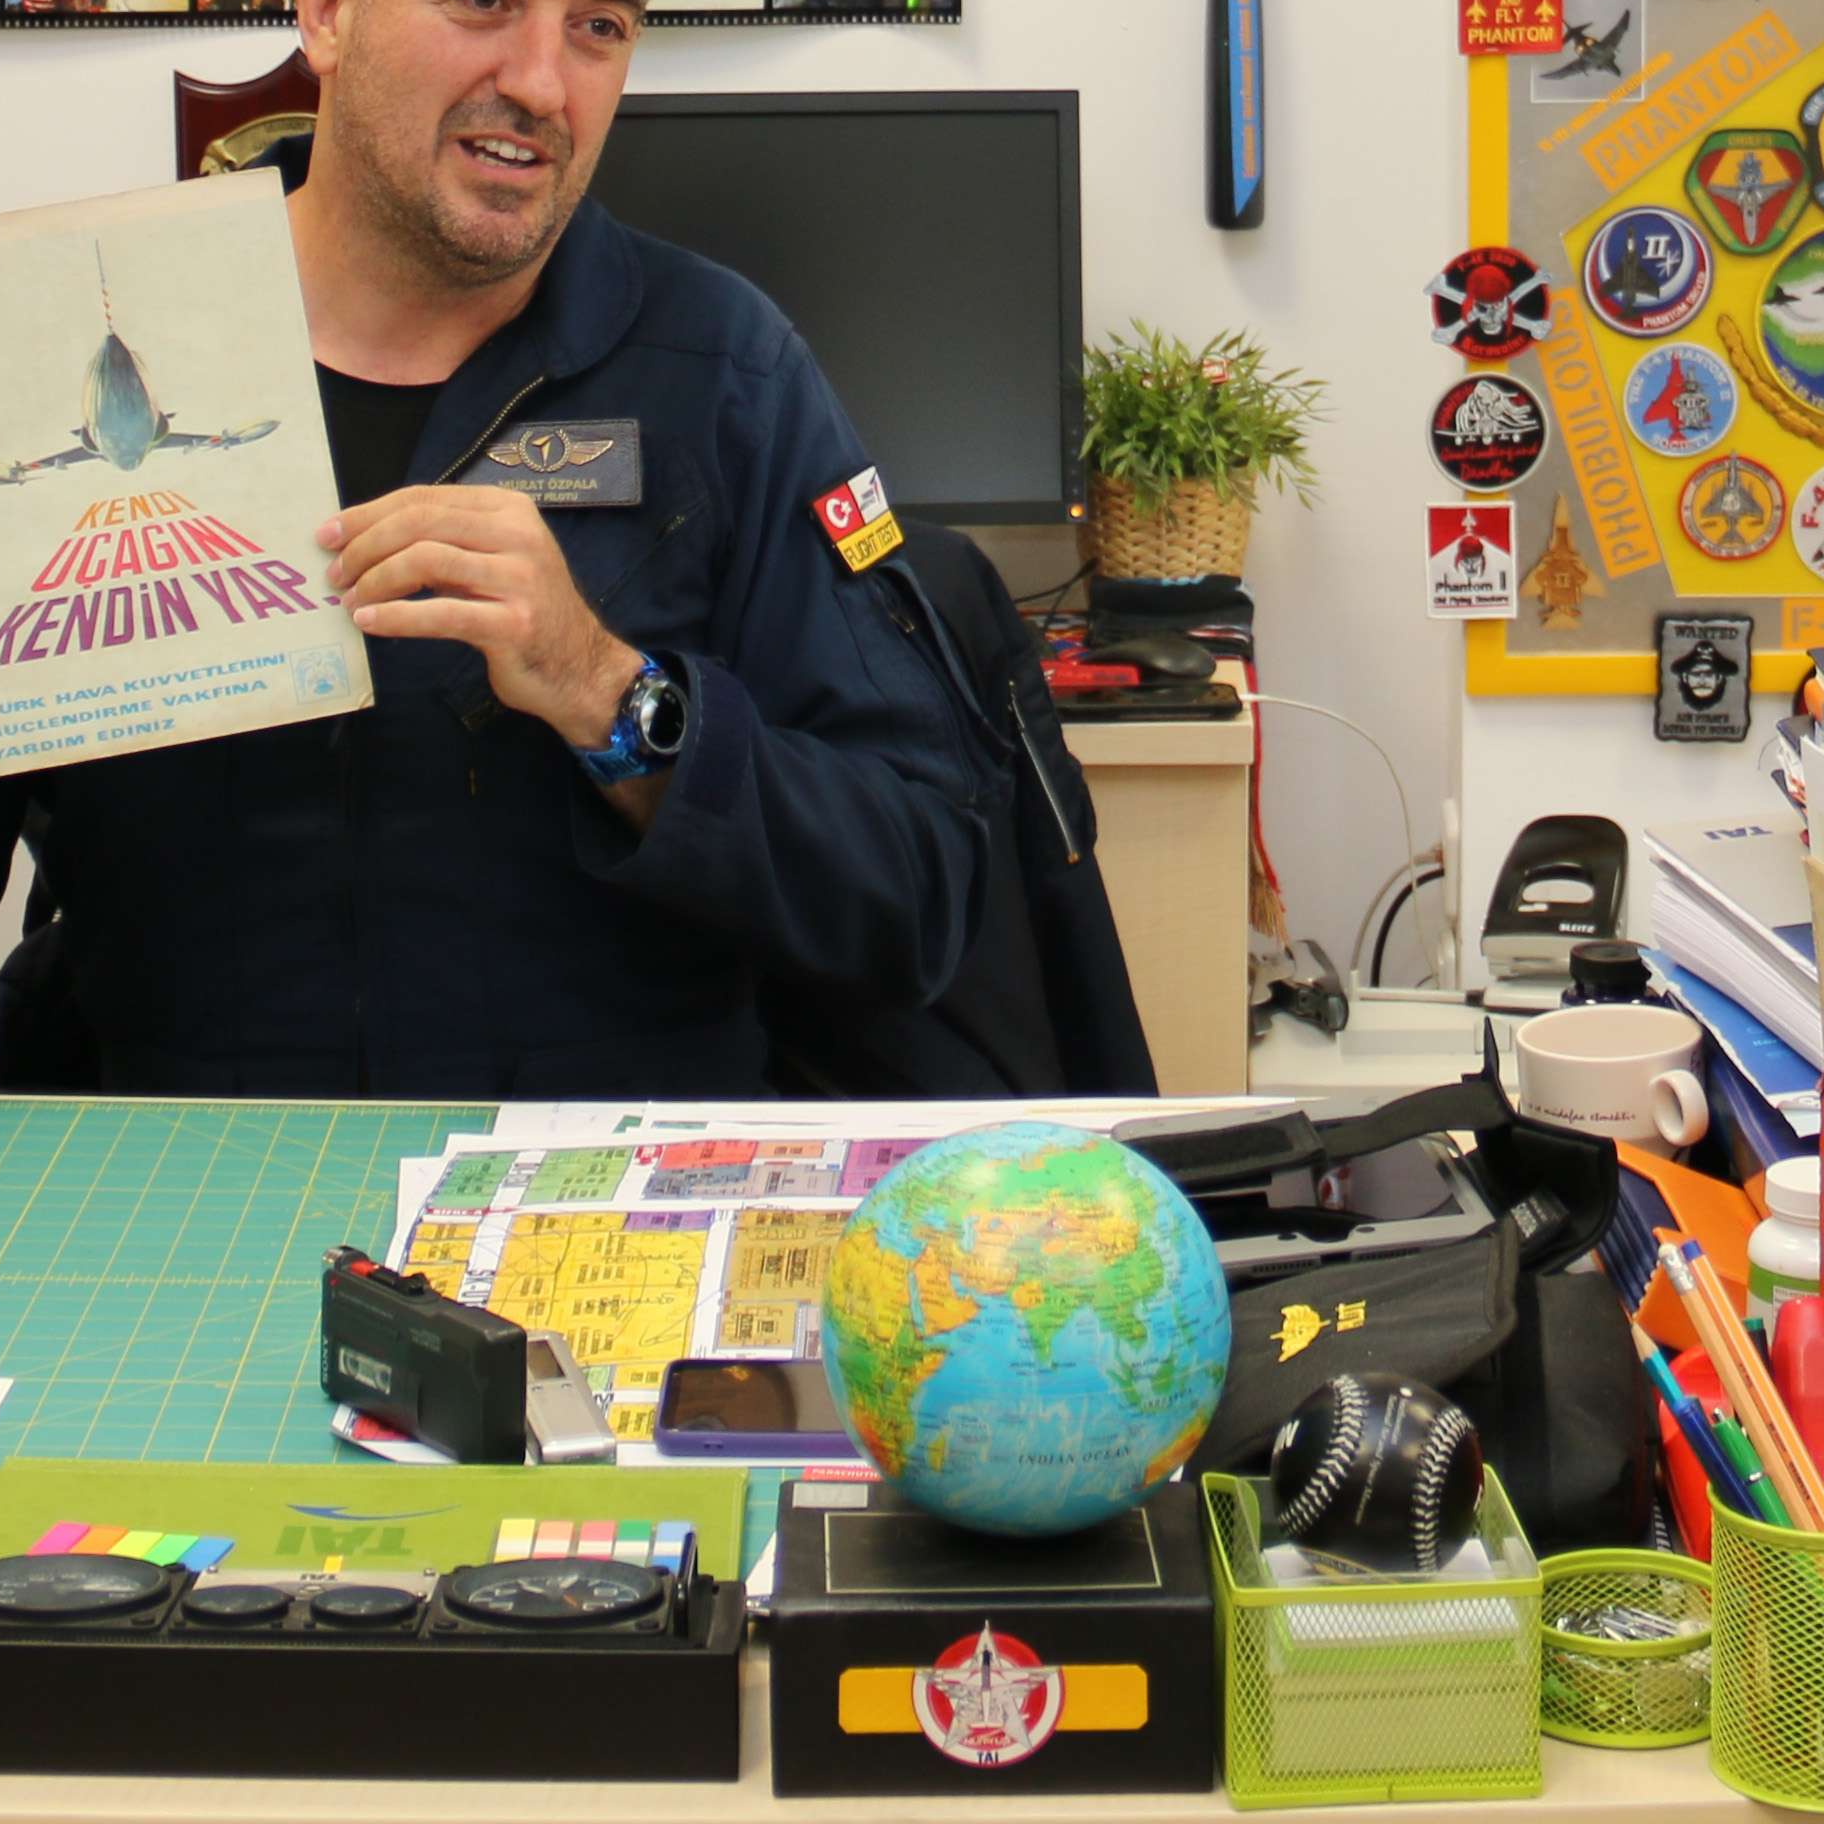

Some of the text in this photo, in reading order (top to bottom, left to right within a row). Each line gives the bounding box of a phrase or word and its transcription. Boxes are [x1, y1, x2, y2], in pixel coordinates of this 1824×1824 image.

[1495, 8, 1524, 24] FLY
[1467, 26, 1554, 45] PHANTOM
[1595, 20, 1783, 178] PHANTOM
[546, 474, 598, 491] ÖZPALA
[843, 520, 898, 570] FLIGHT TEST
[1434, 573, 1494, 594] Phantom
[1676, 626, 1739, 640] WANTED
[55, 684, 118, 707] HAVA
[161, 678, 268, 709] VAKFINA
[1018, 1446, 1133, 1467] INDIAN OCEAN
[277, 1526, 413, 1558] TAI
[976, 1750, 1000, 1765] TAI
